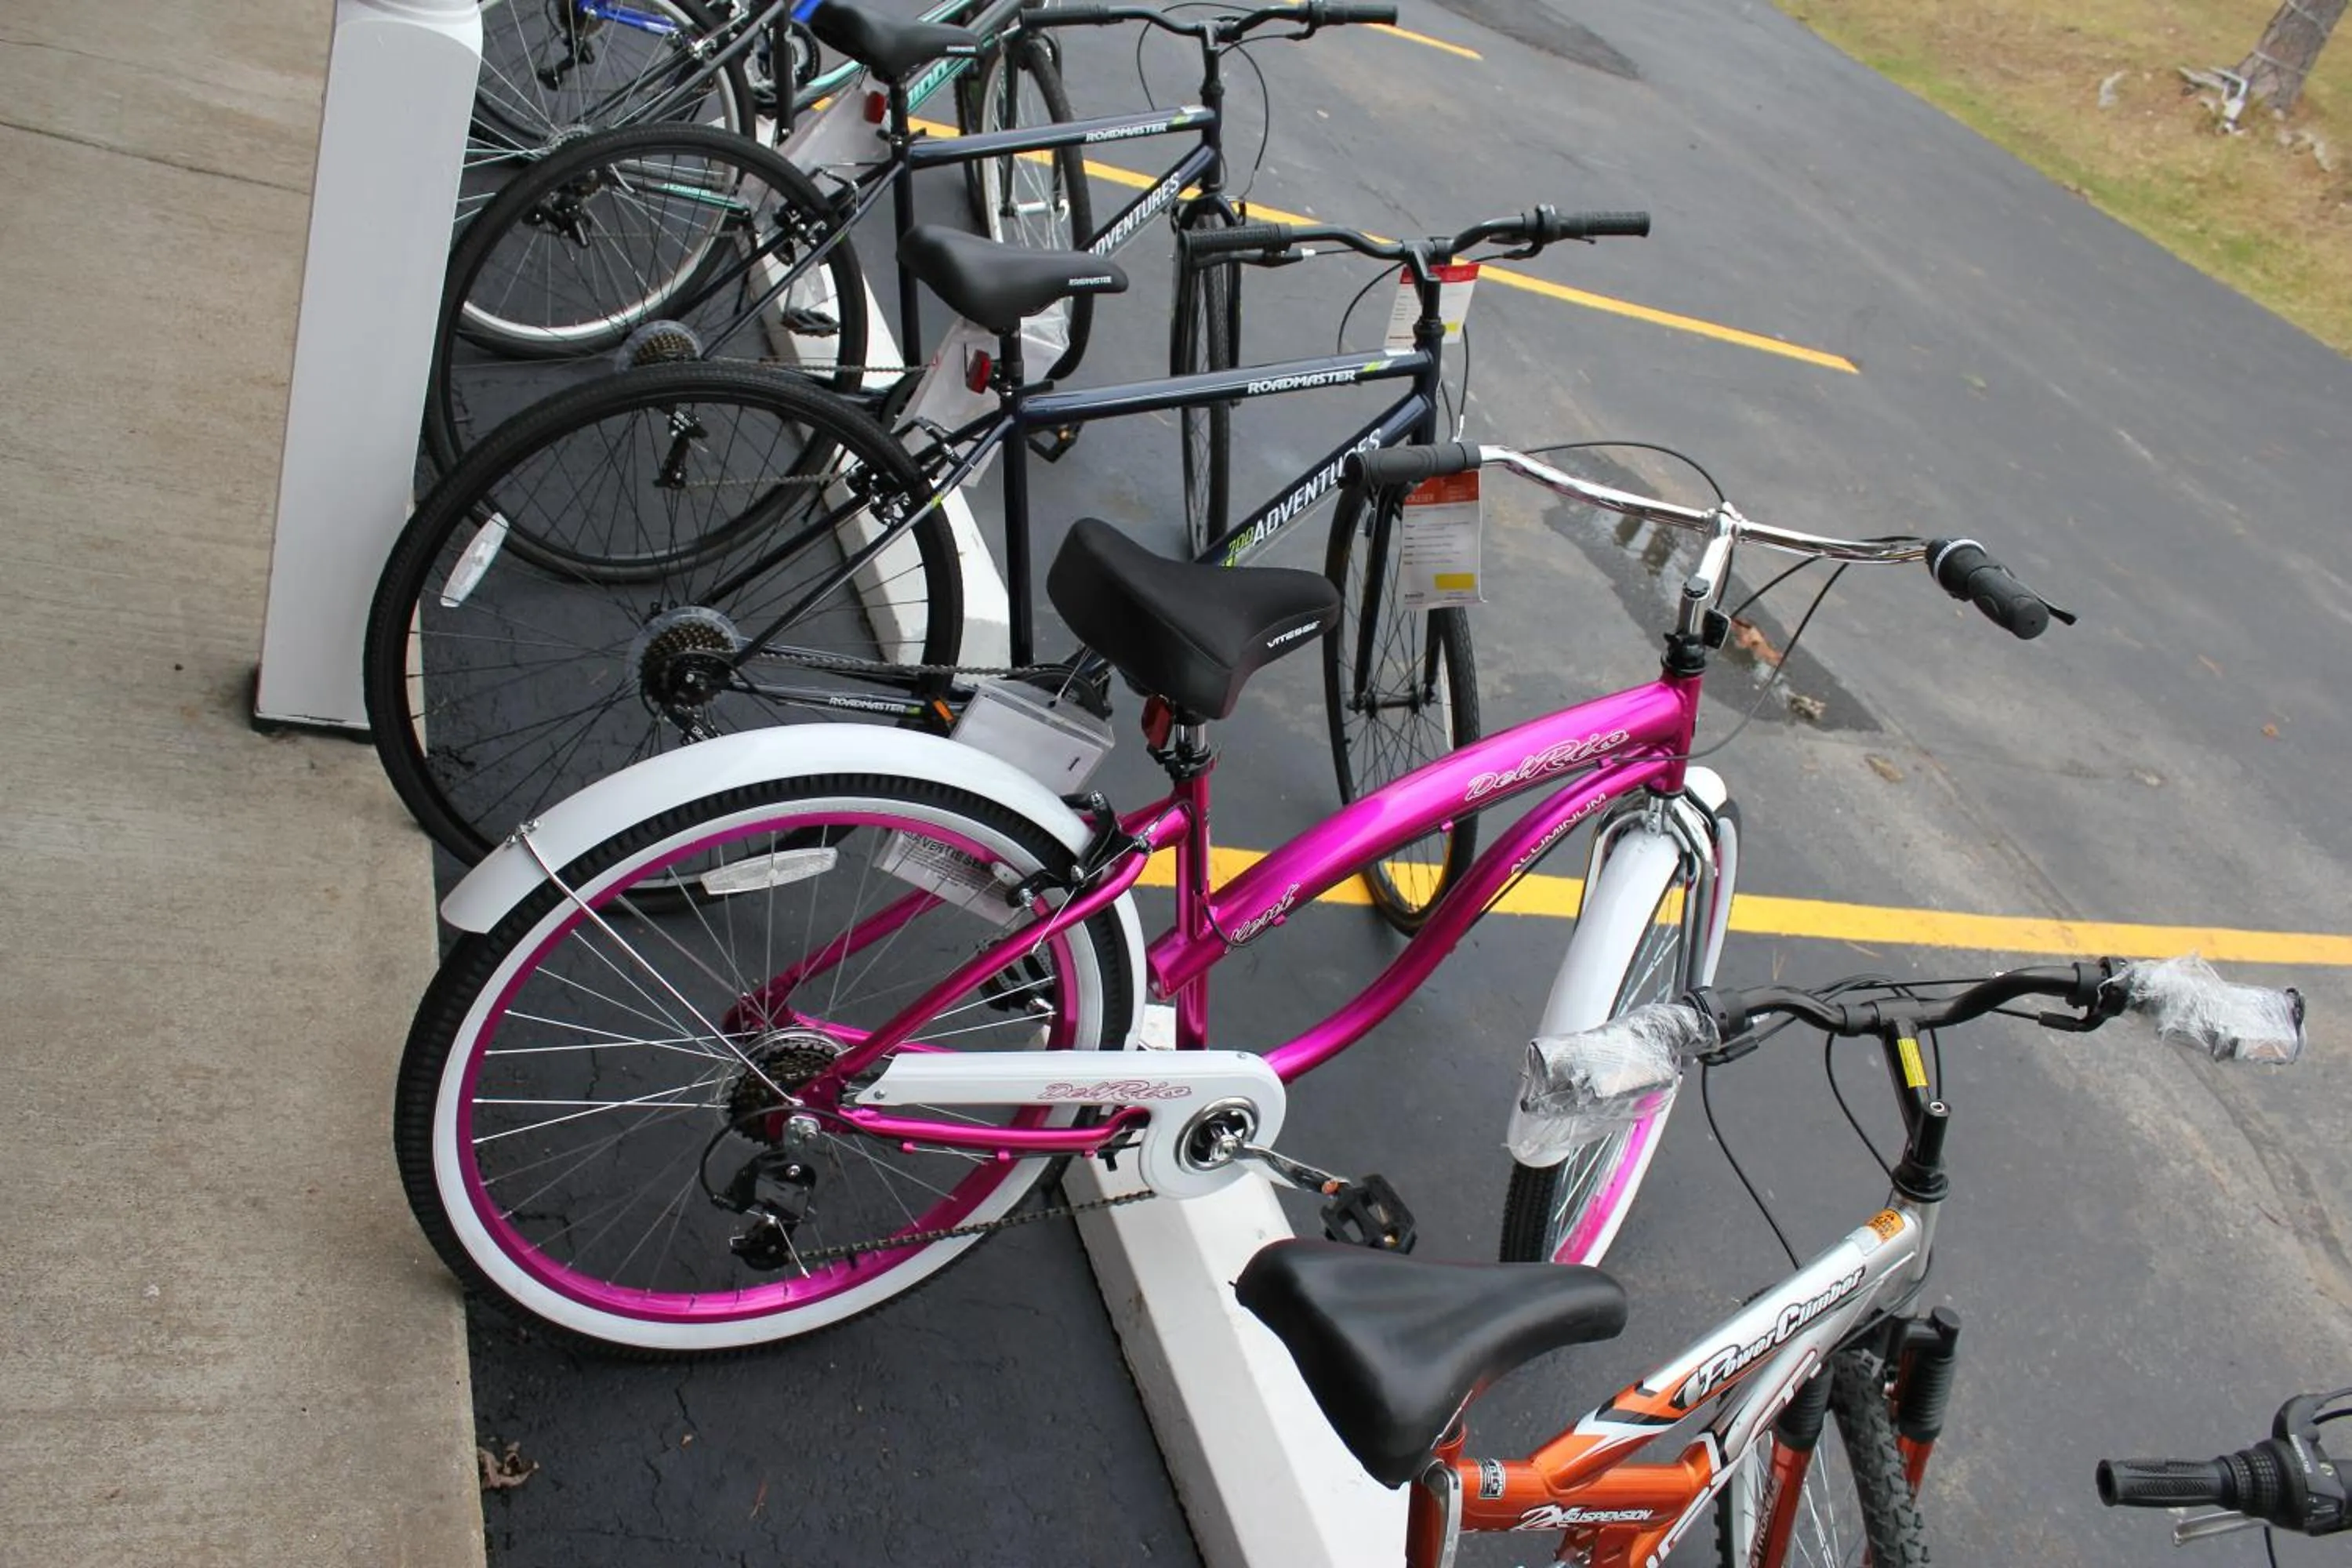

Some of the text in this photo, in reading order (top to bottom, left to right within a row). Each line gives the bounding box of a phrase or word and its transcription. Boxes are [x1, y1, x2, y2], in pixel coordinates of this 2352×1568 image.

[1086, 122, 1167, 142] ROADMASTER
[1087, 172, 1181, 257] DVENTURES
[1247, 369, 1356, 394] ROADMASTER
[829, 696, 906, 713] ROADMASTER
[1511, 792, 1607, 873] ALUMINUM
